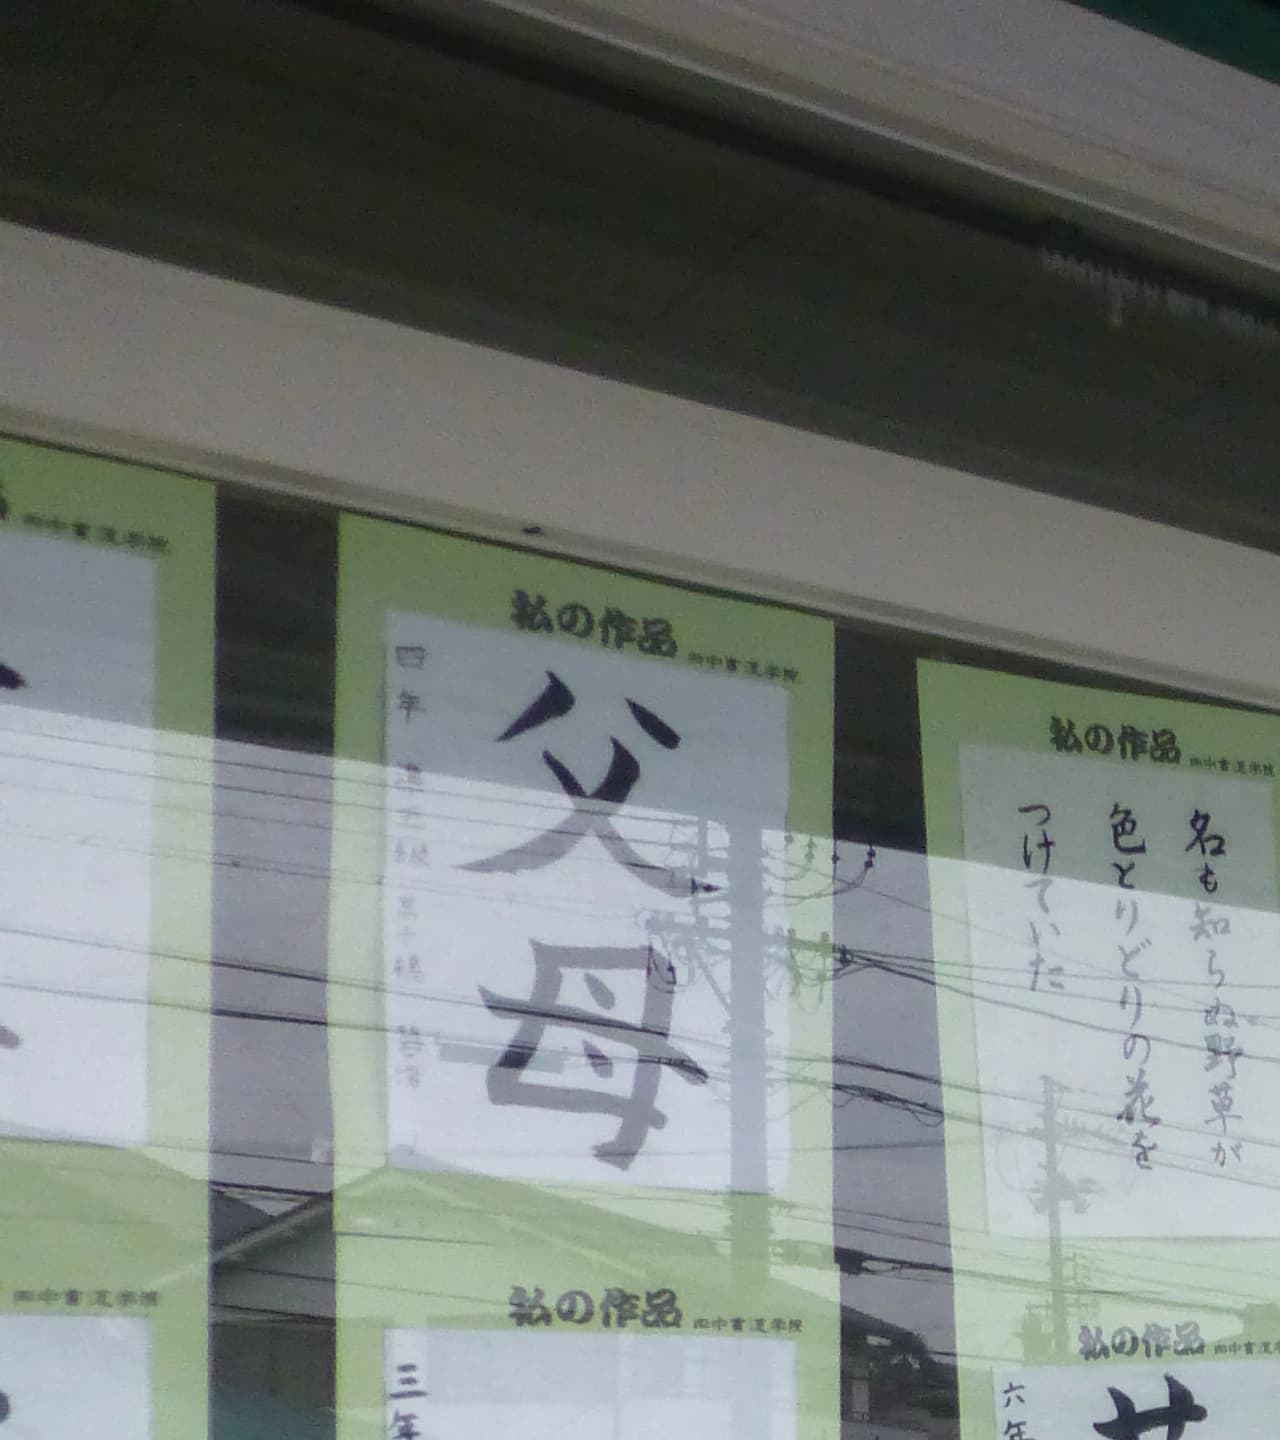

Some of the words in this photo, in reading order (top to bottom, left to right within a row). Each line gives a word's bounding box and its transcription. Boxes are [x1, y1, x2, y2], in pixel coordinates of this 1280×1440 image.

[510, 588, 679, 658] 私の作品
[1049, 716, 1180, 763] 私の作品
[453, 669, 723, 1170] 父母
[1018, 804, 1065, 992] つけていた
[1109, 802, 1161, 1171] 色とりどりの花を
[508, 1286, 683, 1328] 私の作品
[1078, 1321, 1205, 1360] 私の作品
